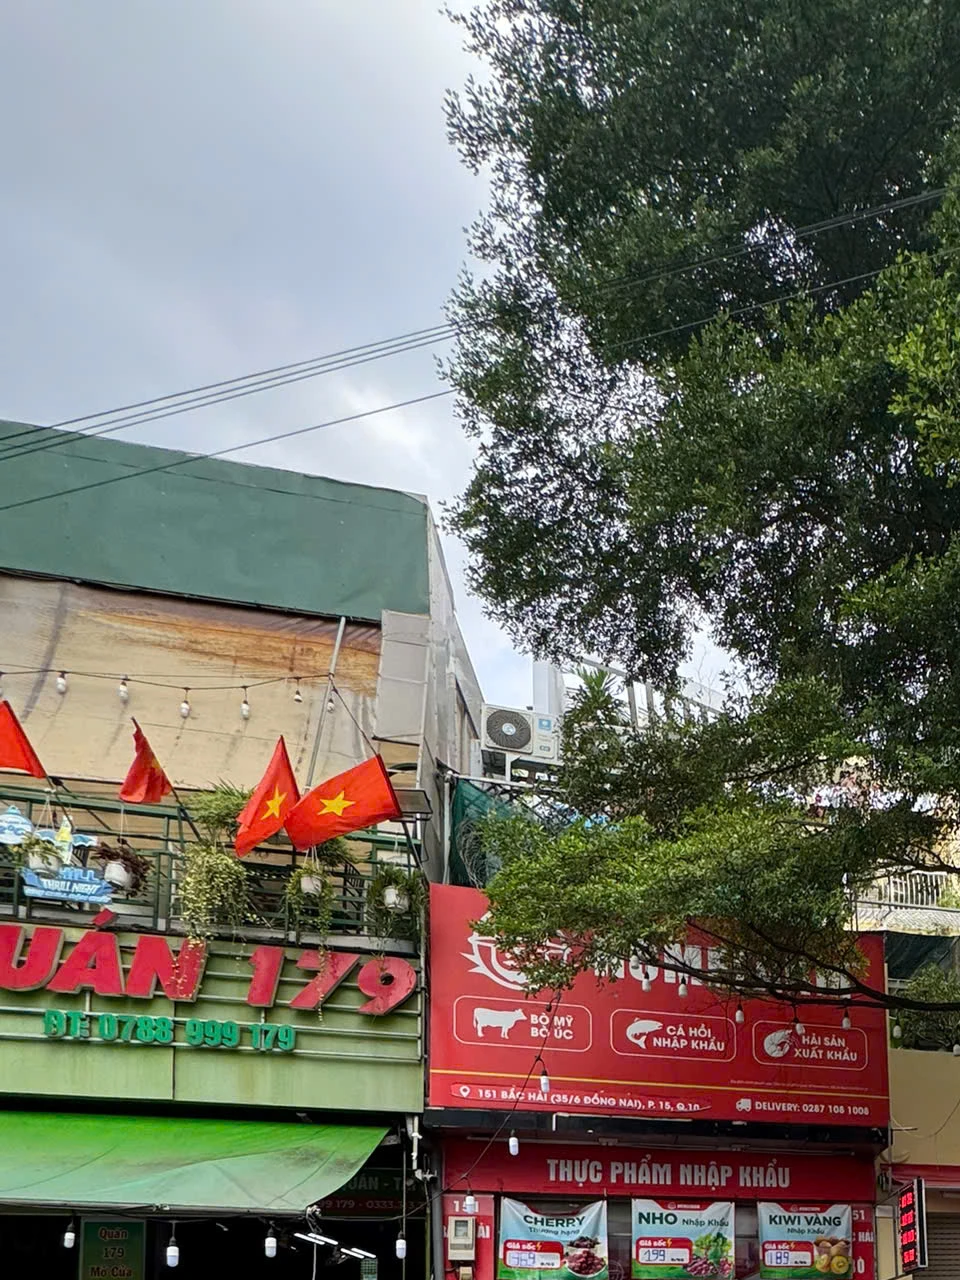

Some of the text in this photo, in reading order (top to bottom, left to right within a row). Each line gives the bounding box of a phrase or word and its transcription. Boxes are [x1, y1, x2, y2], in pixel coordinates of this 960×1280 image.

[247, 946, 417, 1016] 179
[531, 1013, 573, 1027] BÒ MỸ
[99, 1014, 174, 1043] 0788
[185, 1019, 240, 1047] 999
[250, 1023, 296, 1051] 179
[531, 1026, 573, 1040] BÒ ÚC
[666, 1024, 711, 1038] CÁ HỒI
[653, 1036, 725, 1051] NHẬP KHẨU
[794, 1047, 858, 1061] XUẤT KHẨU
[478, 1089, 497, 1099] 151
[551, 1095, 580, 1106] (35/6
[583, 1091, 616, 1107] ĐỒNG
[755, 1101, 869, 1115] DELIVERY: 0287 108 1008
[547, 1154, 790, 1191] THỰC PHẨM NHẬP KHẨU
[523, 1215, 585, 1228] CHERRY
[638, 1212, 678, 1225] NHO
[682, 1218, 705, 1227] Nhập
[769, 1213, 842, 1226] KIWI VÀNG
